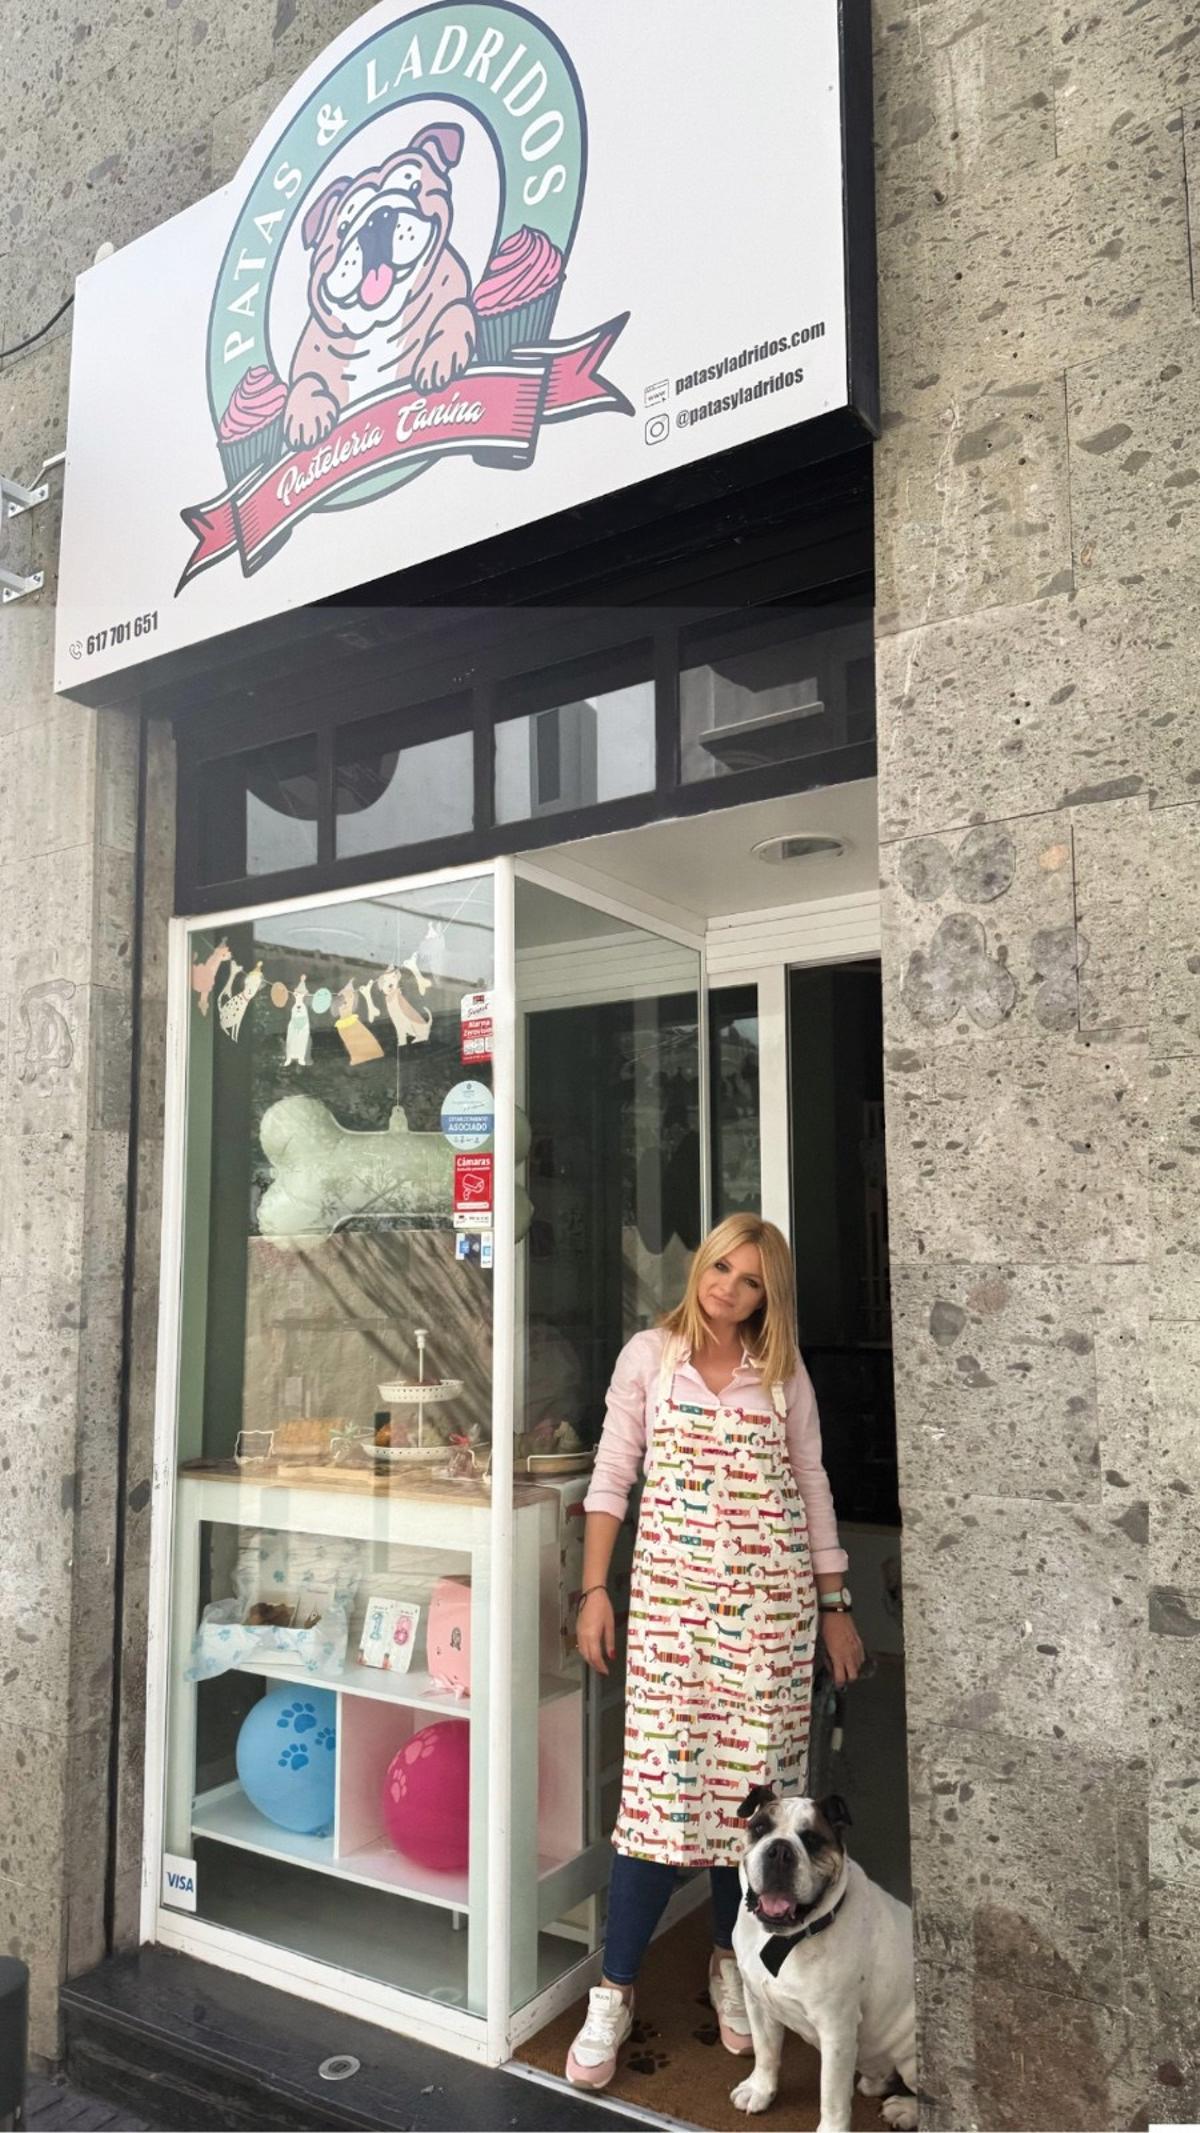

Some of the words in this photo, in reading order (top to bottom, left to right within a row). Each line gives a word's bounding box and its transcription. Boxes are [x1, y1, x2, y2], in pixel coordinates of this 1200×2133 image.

[223, 161, 303, 365] PATAS
[316, 103, 349, 147] &
[365, 24, 568, 207] LADRIDOS
[674, 321, 826, 395] patasyladridos.com
[675, 367, 804, 429] @patasyladridos
[276, 423, 384, 507] Pastelería
[87, 630, 108, 655] 617
[110, 620, 132, 647] 701
[134, 610, 158, 637] 651
[448, 1122, 488, 1132] ASOCIADO
[456, 1157, 491, 1167] Cámaras
[166, 1871, 194, 1893] VISA
